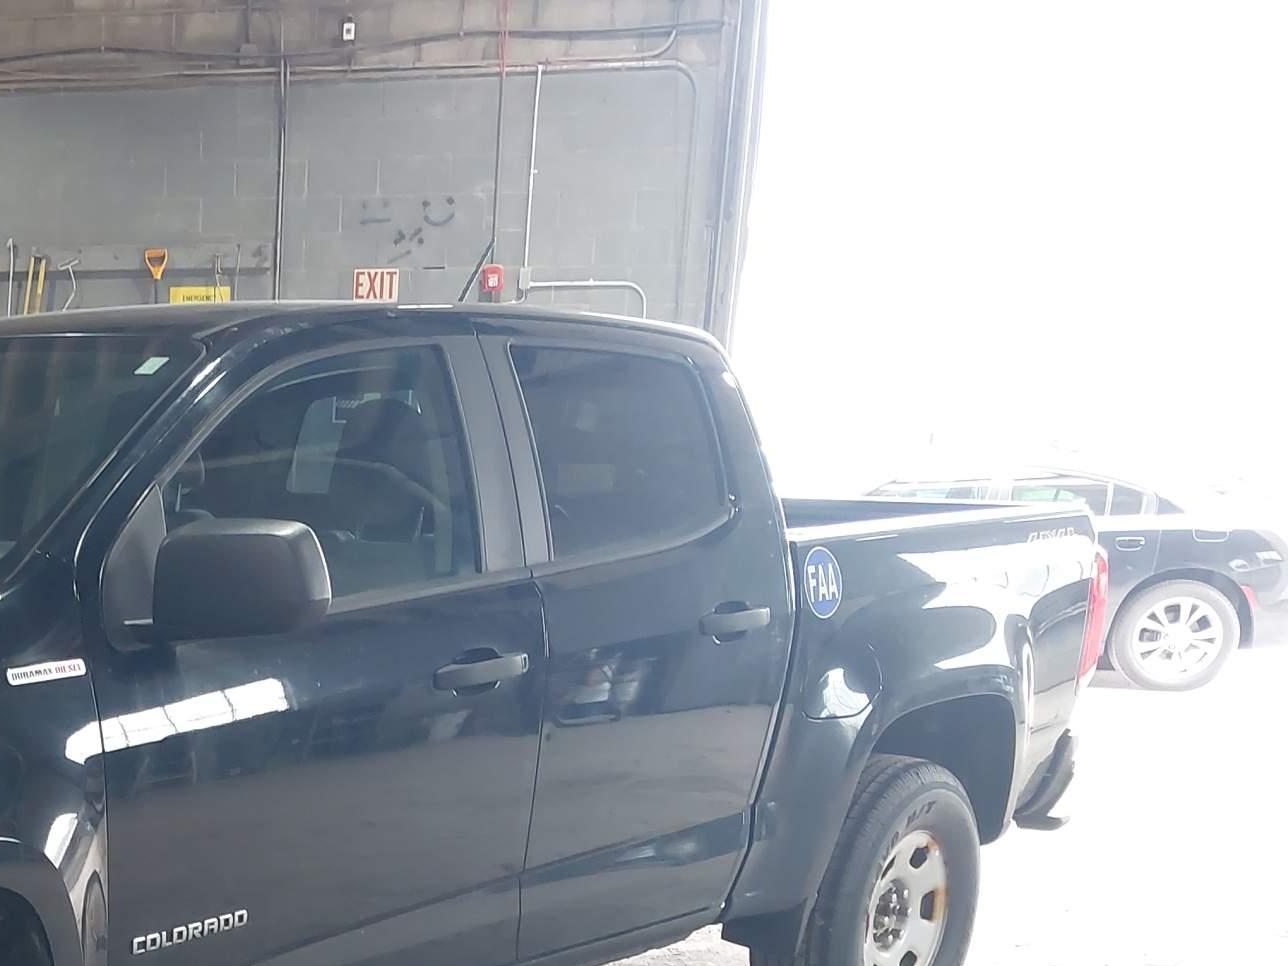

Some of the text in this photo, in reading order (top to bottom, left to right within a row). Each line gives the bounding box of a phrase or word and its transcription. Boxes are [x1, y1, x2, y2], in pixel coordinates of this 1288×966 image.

[182, 294, 218, 303] EMERGENC
[355, 271, 398, 299] EXIT
[807, 562, 839, 603] FAA
[11, 663, 82, 681] DURAMAX DIESEL
[132, 909, 248, 955] COLORADO
